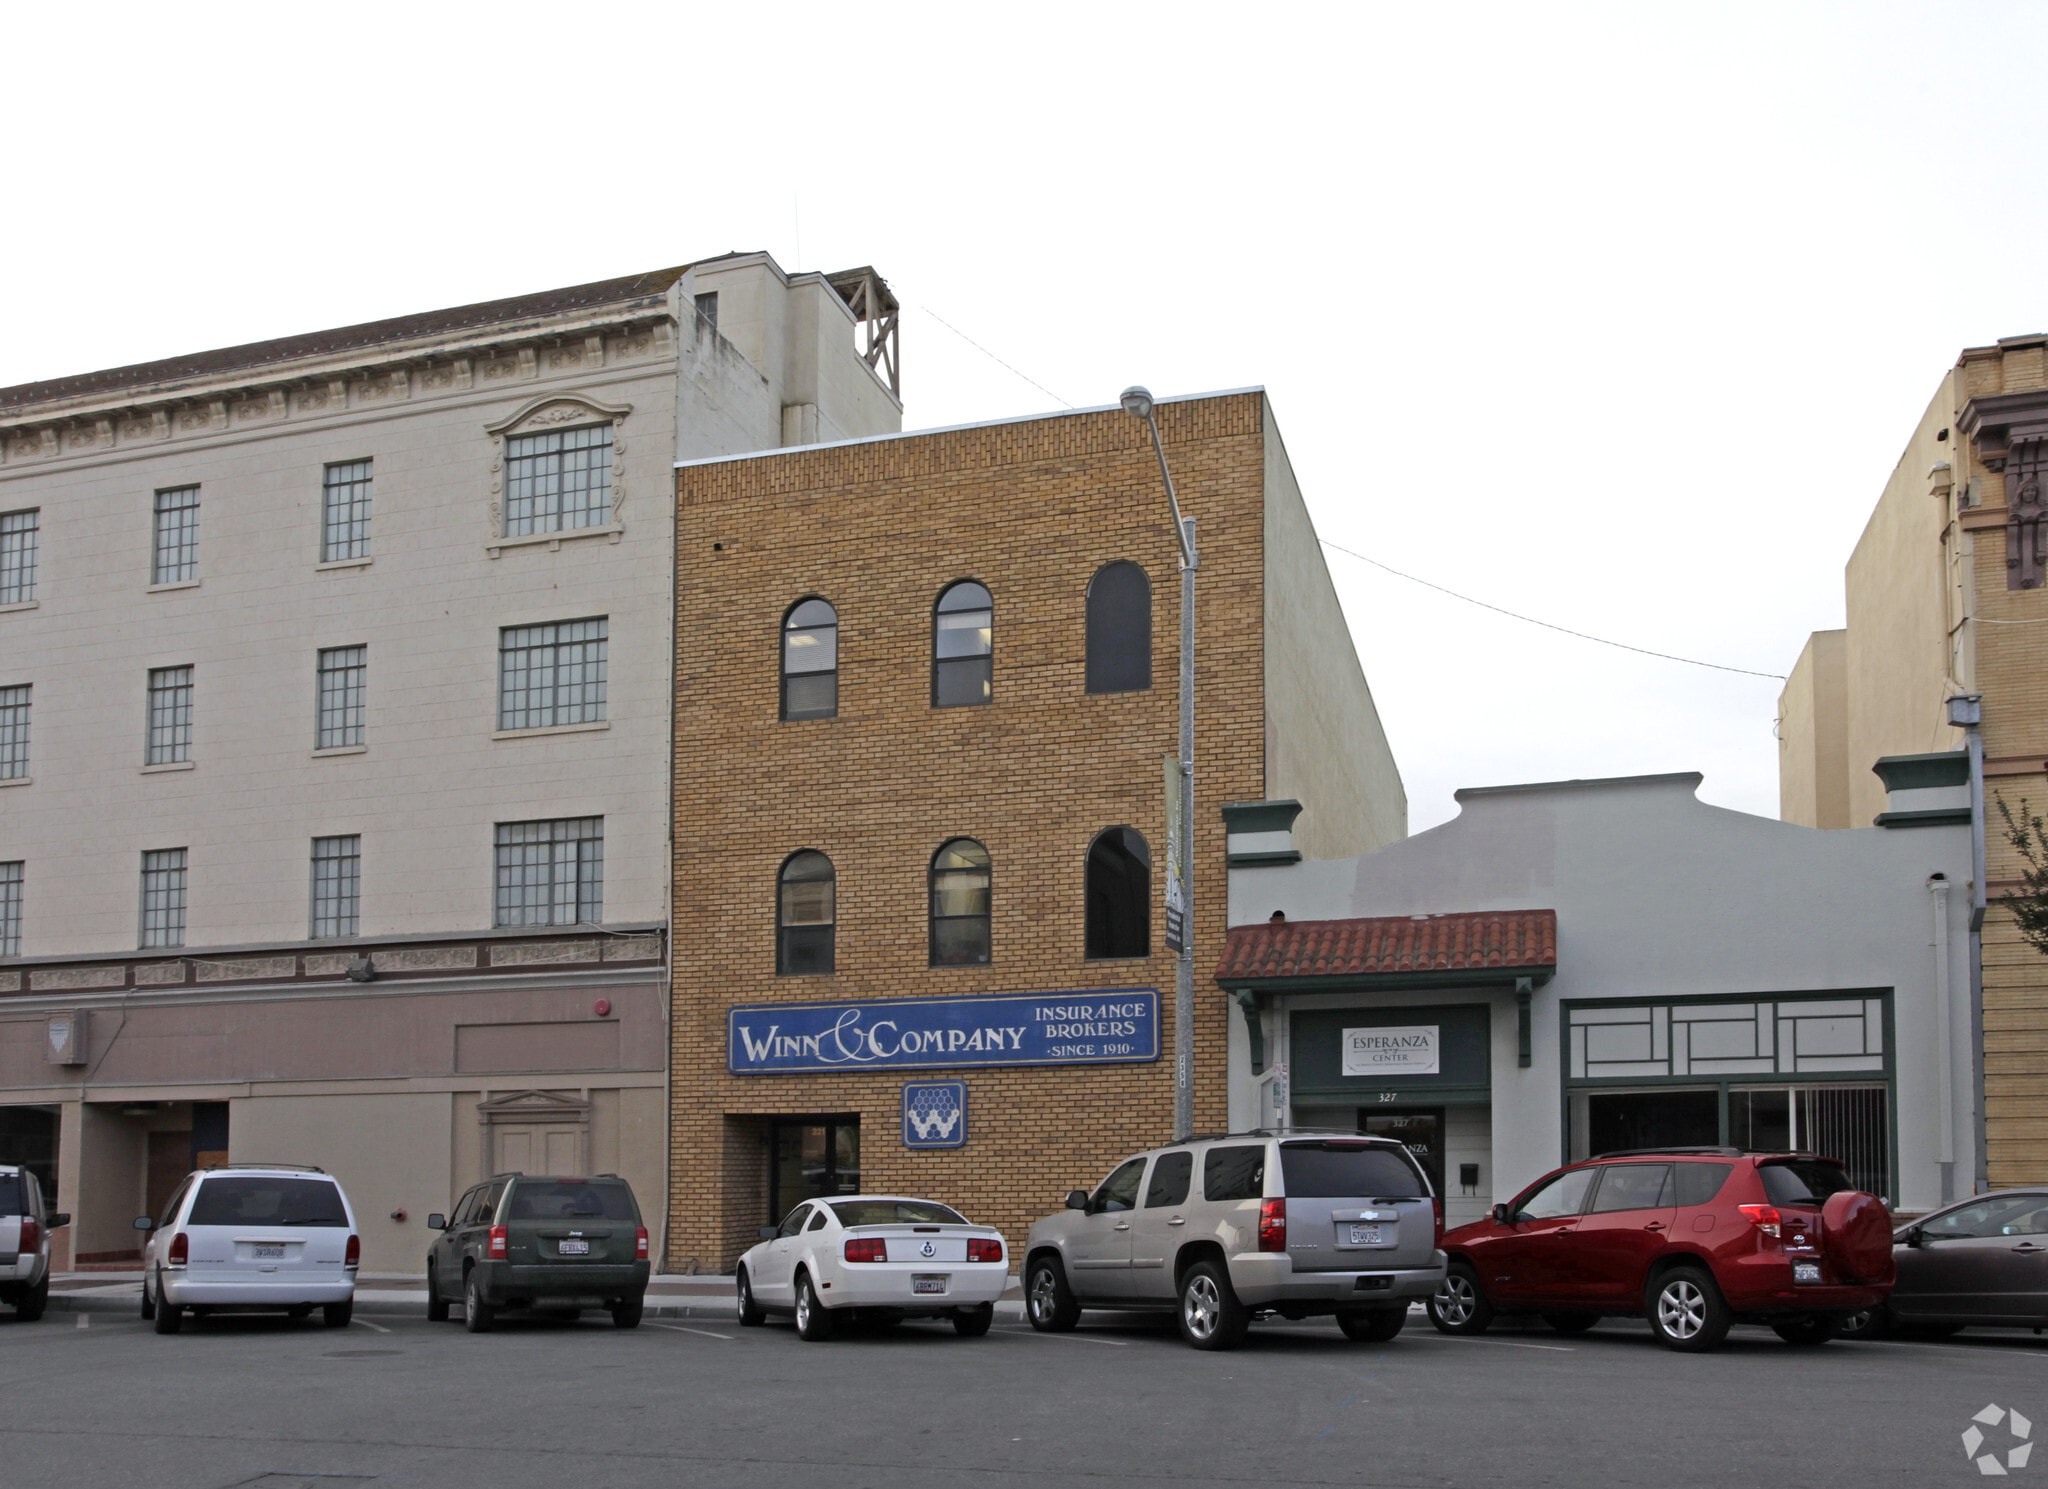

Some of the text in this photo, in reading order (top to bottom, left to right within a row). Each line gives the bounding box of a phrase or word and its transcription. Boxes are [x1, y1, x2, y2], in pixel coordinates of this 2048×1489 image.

[1035, 1003, 1146, 1021] INSURANCE
[1046, 1021, 1136, 1039] BROKERS
[868, 1020, 1026, 1057] COMPANY
[1353, 1035, 1429, 1049] ESPERANZA
[1051, 1043, 1130, 1057] SINCE 1910
[1372, 1054, 1409, 1062] CENTER
[1378, 1093, 1398, 1103] 327
[1392, 1119, 1409, 1128] 327
